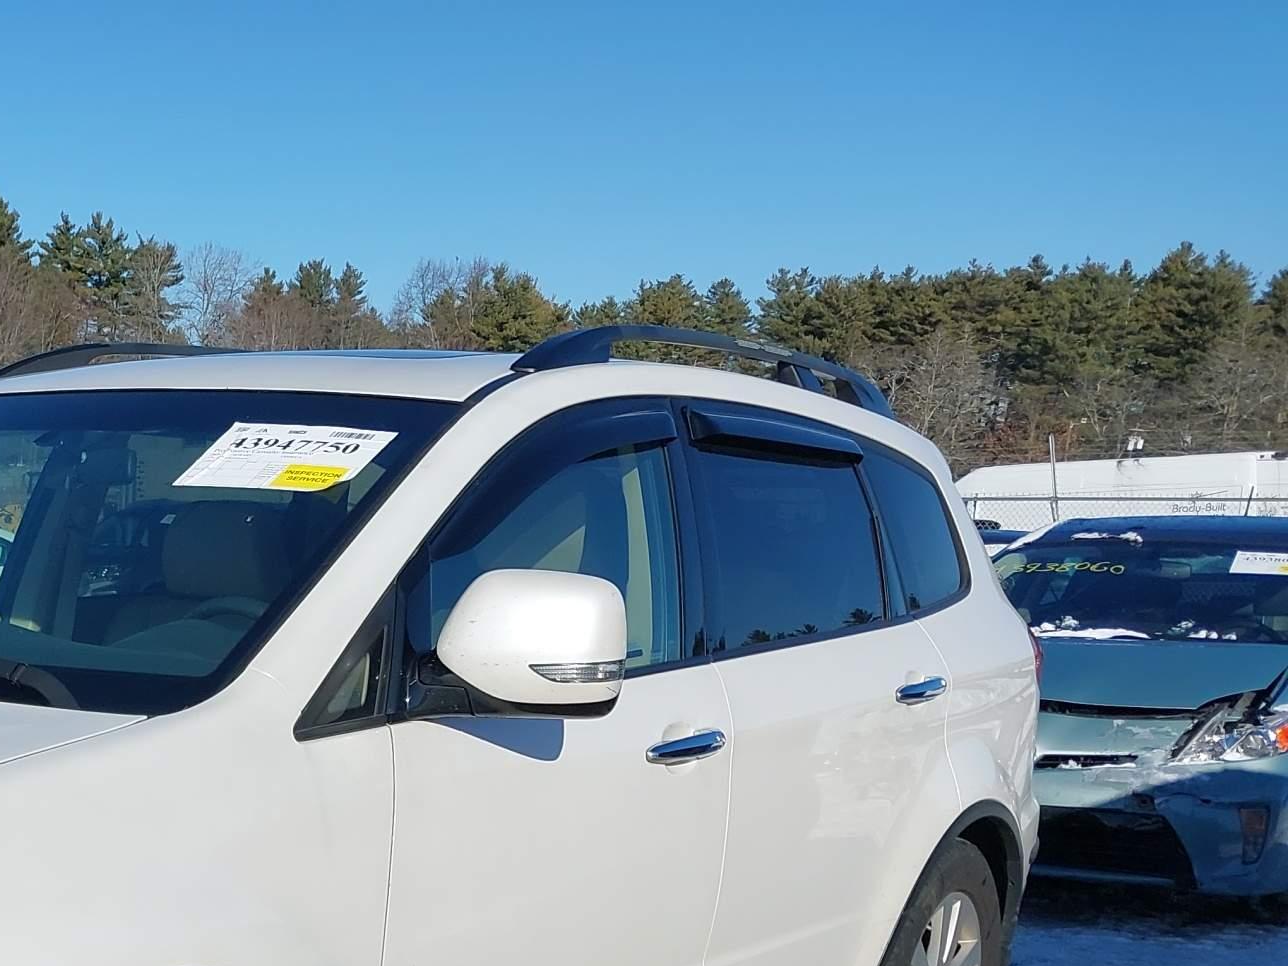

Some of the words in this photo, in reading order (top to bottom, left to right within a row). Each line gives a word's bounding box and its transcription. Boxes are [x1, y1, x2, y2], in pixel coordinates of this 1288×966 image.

[230, 436, 361, 455] 43947750
[284, 469, 342, 478] INSPECTION
[286, 476, 330, 484] SERVICE
